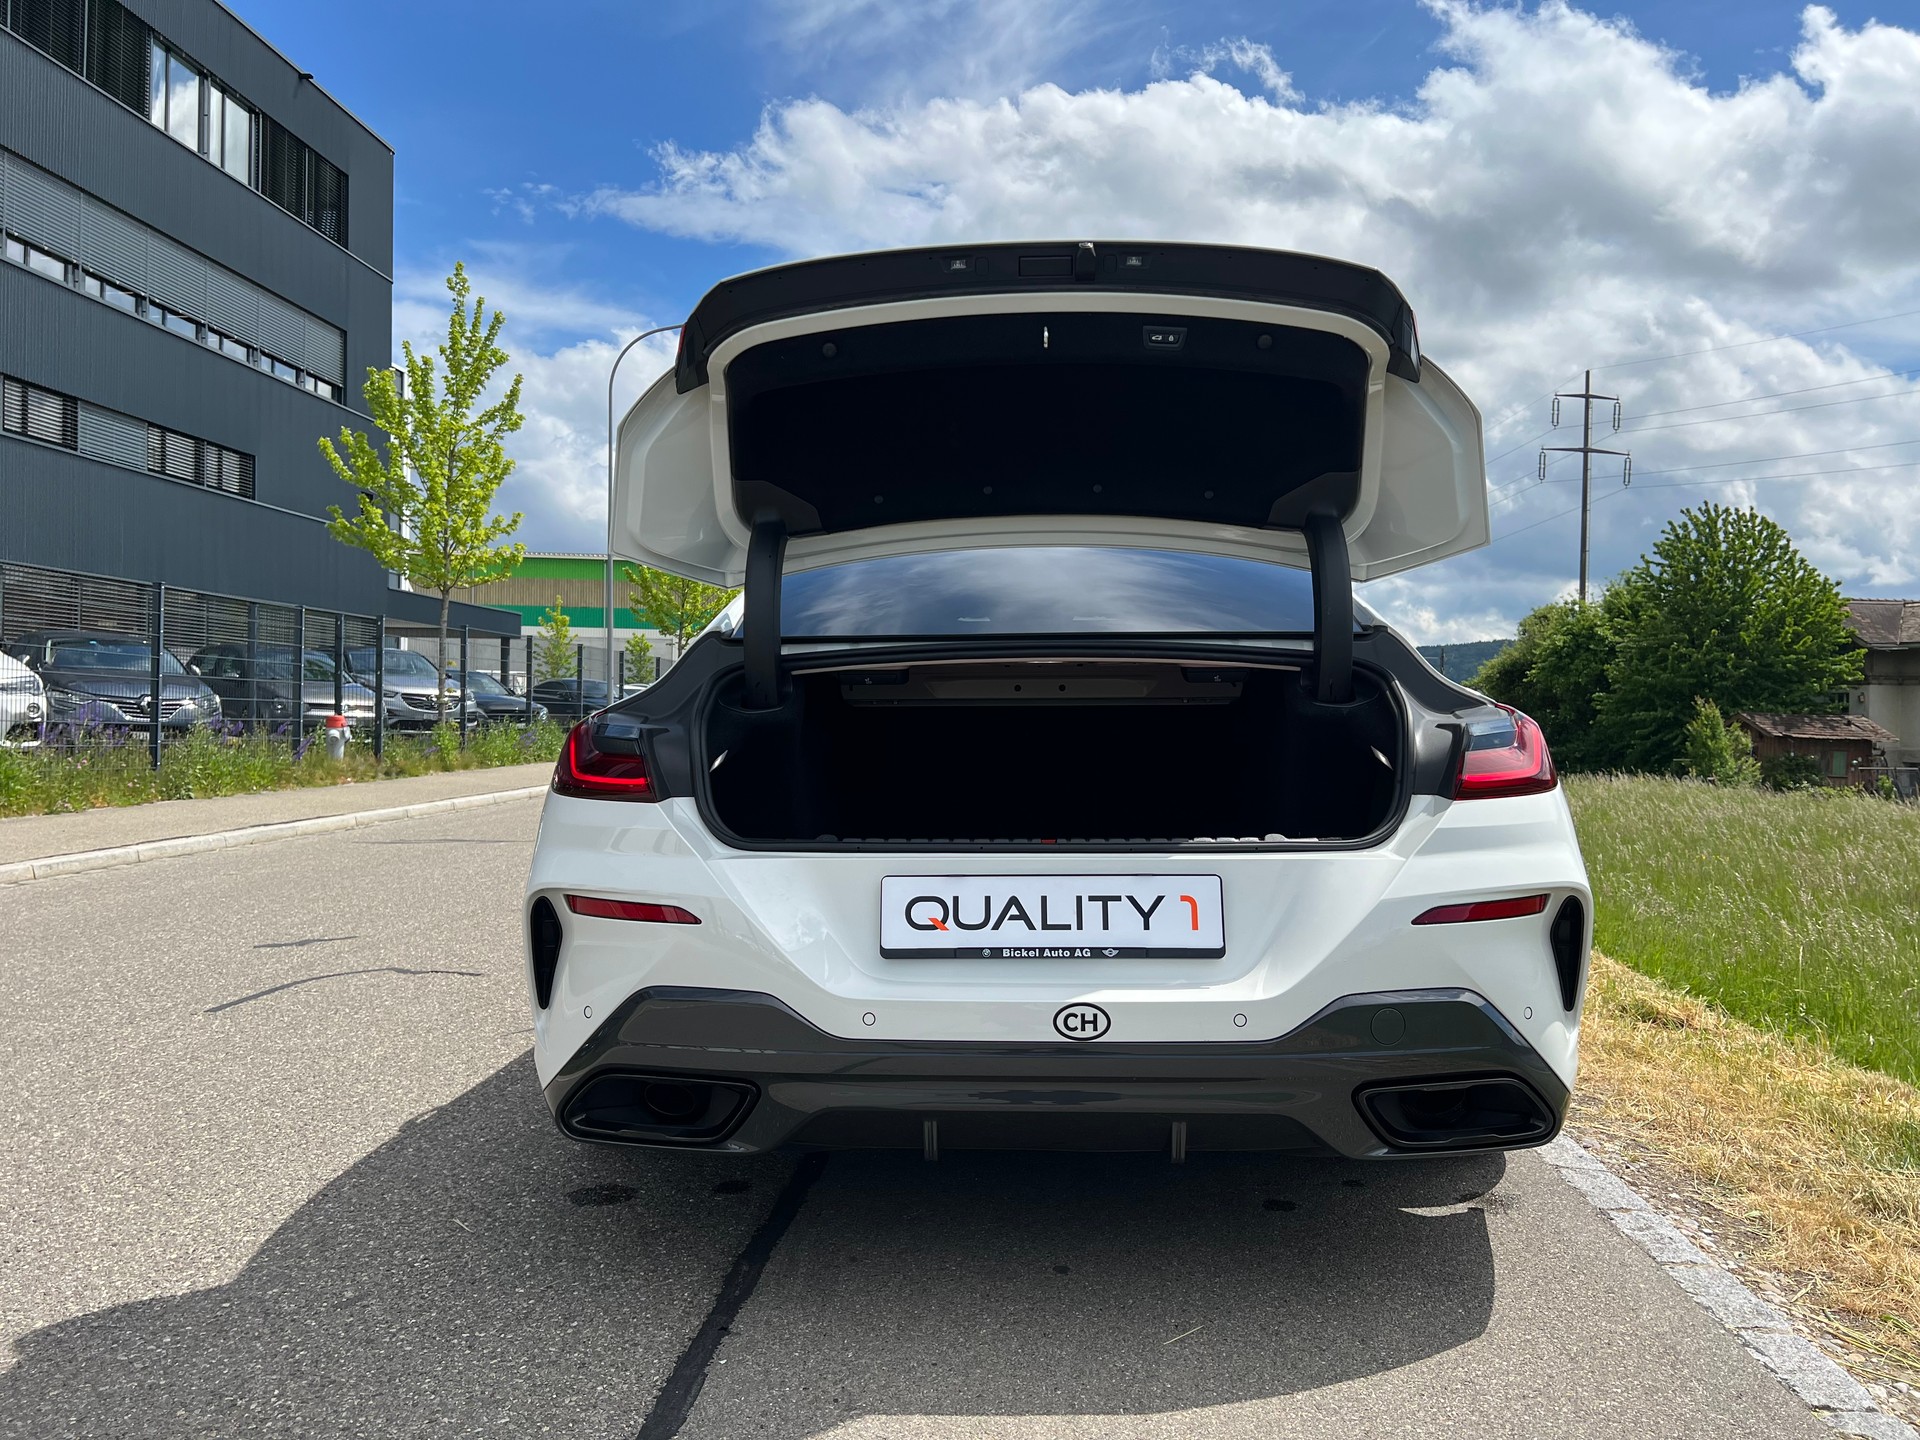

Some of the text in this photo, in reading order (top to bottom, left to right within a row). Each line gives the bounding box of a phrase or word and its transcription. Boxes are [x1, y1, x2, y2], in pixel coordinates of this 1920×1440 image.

[904, 895, 1199, 931] QUALITY 1
[1002, 948, 1092, 958] Bickel Auto AG
[1062, 1012, 1098, 1032] CH
